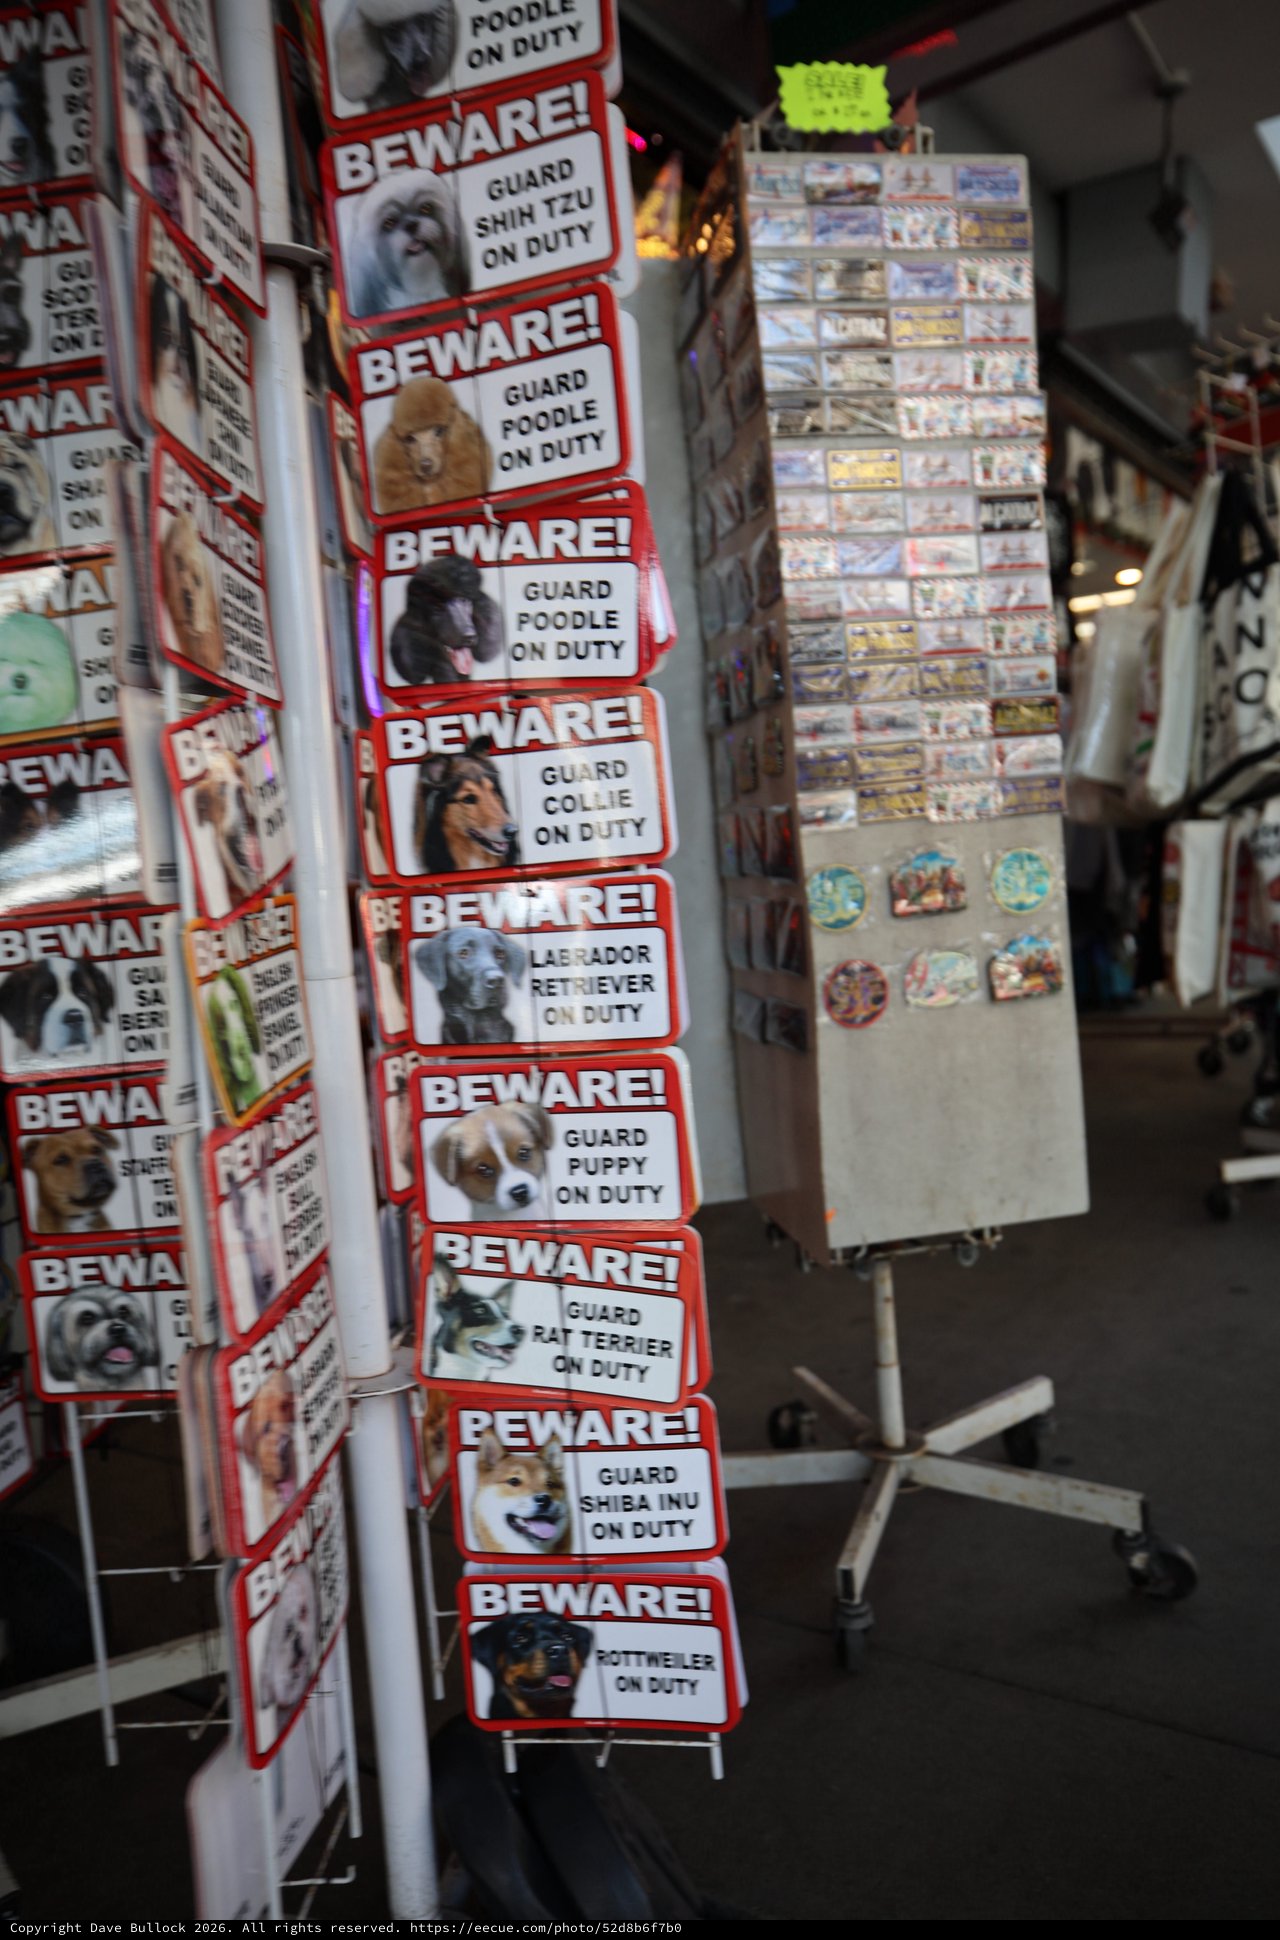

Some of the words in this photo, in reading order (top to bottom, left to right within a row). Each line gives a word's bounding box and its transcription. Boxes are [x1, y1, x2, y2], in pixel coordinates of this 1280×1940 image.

[471, 0, 578, 37] POODLE
[467, 42, 504, 70] ON
[513, 22, 582, 57] DUTY
[332, 80, 591, 190] BEWARE!
[488, 159, 574, 200] GUARD
[475, 205, 536, 238] SHIH
[544, 187, 594, 218] TZU
[482, 243, 517, 269] ON
[525, 221, 595, 258] DUTY
[358, 294, 603, 395] BEWARE!
[504, 369, 588, 406] GUARD
[501, 400, 598, 440] POODLE
[499, 447, 533, 472] ON
[540, 430, 605, 463] DUTY
[384, 518, 632, 571] BEWARE!
[524, 580, 612, 601] GUARD
[518, 610, 620, 630] POODLE
[508, 642, 547, 662] ON
[556, 640, 624, 660] DUTY
[384, 696, 645, 759] BEWARE!
[541, 760, 628, 785] GUARD
[542, 789, 633, 815] COLLIE
[533, 824, 569, 846] ON
[579, 818, 646, 841] DUTY
[410, 884, 658, 933] BEWARE!
[530, 945, 652, 969] LABRADOR
[531, 975, 655, 997] RETRIEVER
[543, 1007, 576, 1026] ON
[584, 1003, 644, 1025] DUTY
[124, 1035, 156, 1052] ON
[421, 1069, 667, 1113] BEWARE!
[564, 1128, 647, 1148] GUARD
[568, 1156, 647, 1176] PUPPY
[557, 1185, 590, 1204] ON
[599, 1184, 664, 1204] DUTY
[433, 1232, 679, 1292] BEWARE!
[567, 1301, 641, 1327] GUARD
[532, 1325, 572, 1346] RAT
[582, 1329, 674, 1359] TERRIER
[553, 1356, 584, 1374] ON
[591, 1360, 650, 1383] DUTY
[459, 1407, 700, 1447] BEWARE!
[599, 1466, 678, 1486] GUARD
[580, 1494, 651, 1514] SHIBA
[660, 1492, 700, 1510] INU
[592, 1521, 625, 1540] ON
[633, 1520, 696, 1540] DUTY
[468, 1582, 713, 1621] BEWARE!
[596, 1650, 717, 1671] ROTTWEILER
[615, 1675, 645, 1692] ON
[650, 1677, 700, 1695] DUTY
